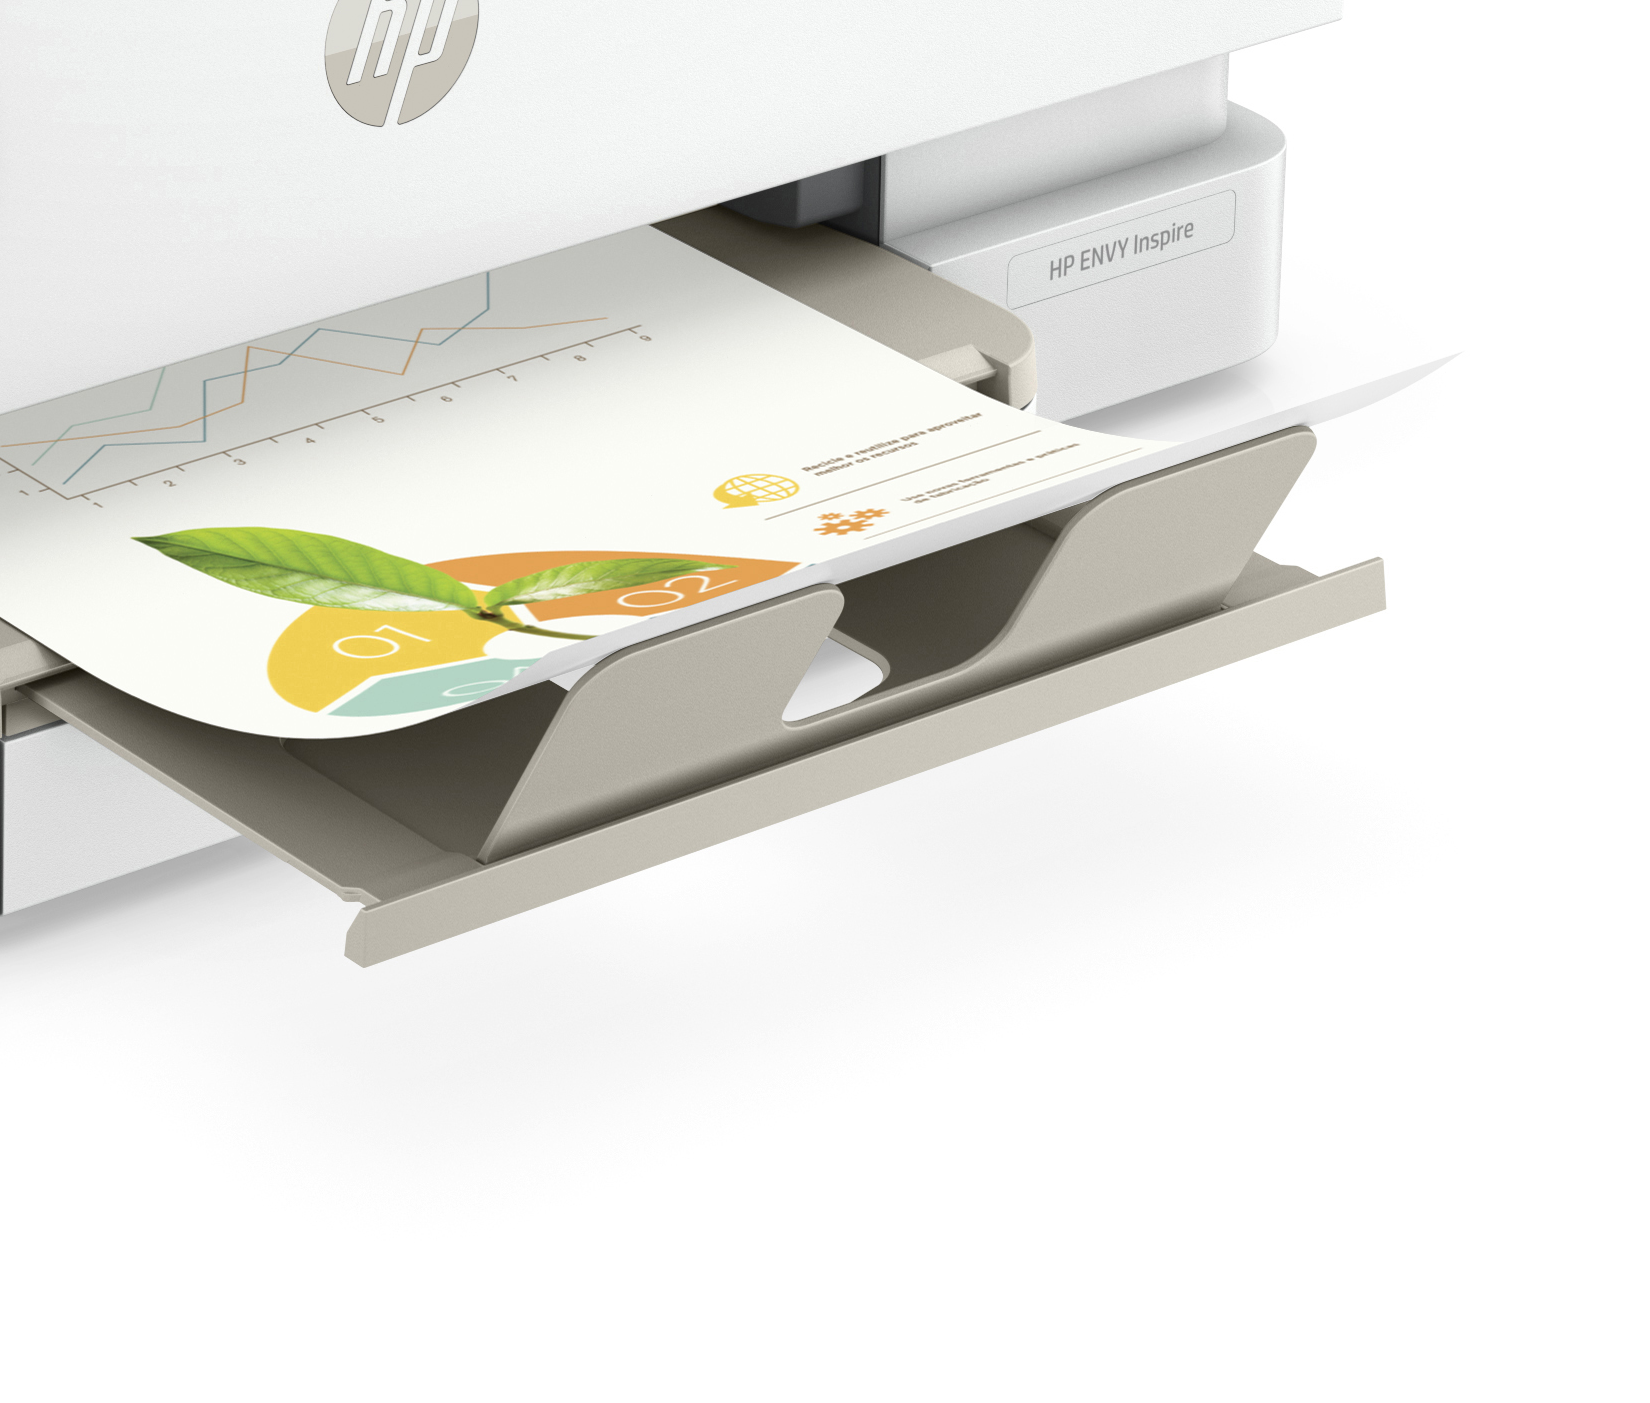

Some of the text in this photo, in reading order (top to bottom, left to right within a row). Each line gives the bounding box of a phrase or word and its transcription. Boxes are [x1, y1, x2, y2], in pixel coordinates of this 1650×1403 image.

[1050, 222, 1194, 281] HP ENVY Inspire
[163, 479, 177, 487] 2
[233, 458, 247, 466] 3
[371, 415, 385, 424] 5
[440, 395, 453, 403] 6
[506, 374, 518, 382] 7
[573, 354, 587, 362] 8
[639, 334, 652, 342] 9
[900, 430, 927, 441] para
[927, 412, 982, 433] aproveitar
[814, 441, 919, 477] melhor os recursos
[616, 575, 739, 608] 02
[332, 624, 432, 659] 01
